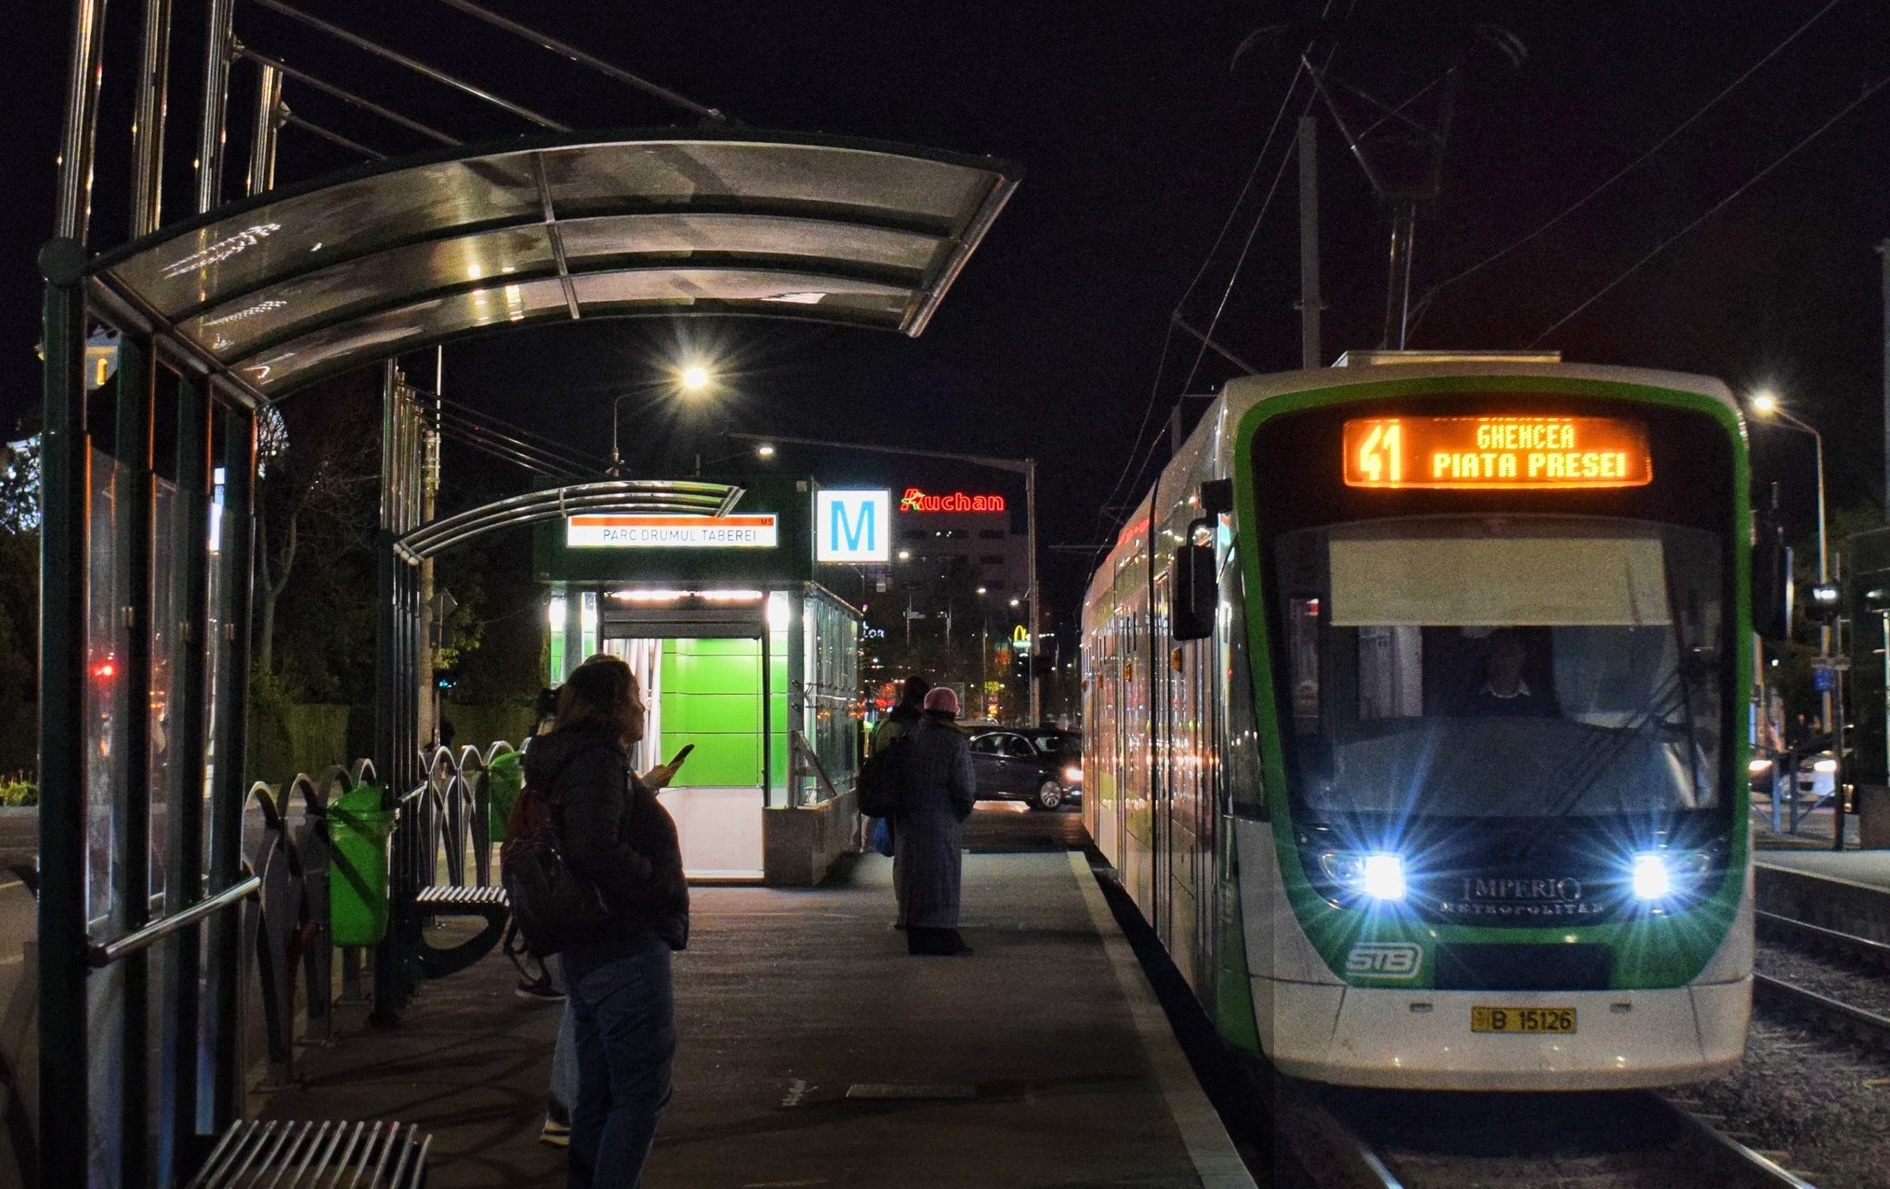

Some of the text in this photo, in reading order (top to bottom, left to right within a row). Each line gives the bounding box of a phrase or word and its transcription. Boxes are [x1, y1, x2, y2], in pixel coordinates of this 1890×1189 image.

[1359, 424, 1401, 482] 41
[1432, 452, 1627, 478] PIATA PRESEI
[900, 488, 1004, 511] Auchan
[603, 529, 757, 542] PARC DRUMUL TABEREI
[831, 500, 875, 552] M
[1462, 877, 1582, 901] IMPERIO
[1345, 949, 1414, 972] STB
[1491, 1009, 1572, 1031] B 15126
